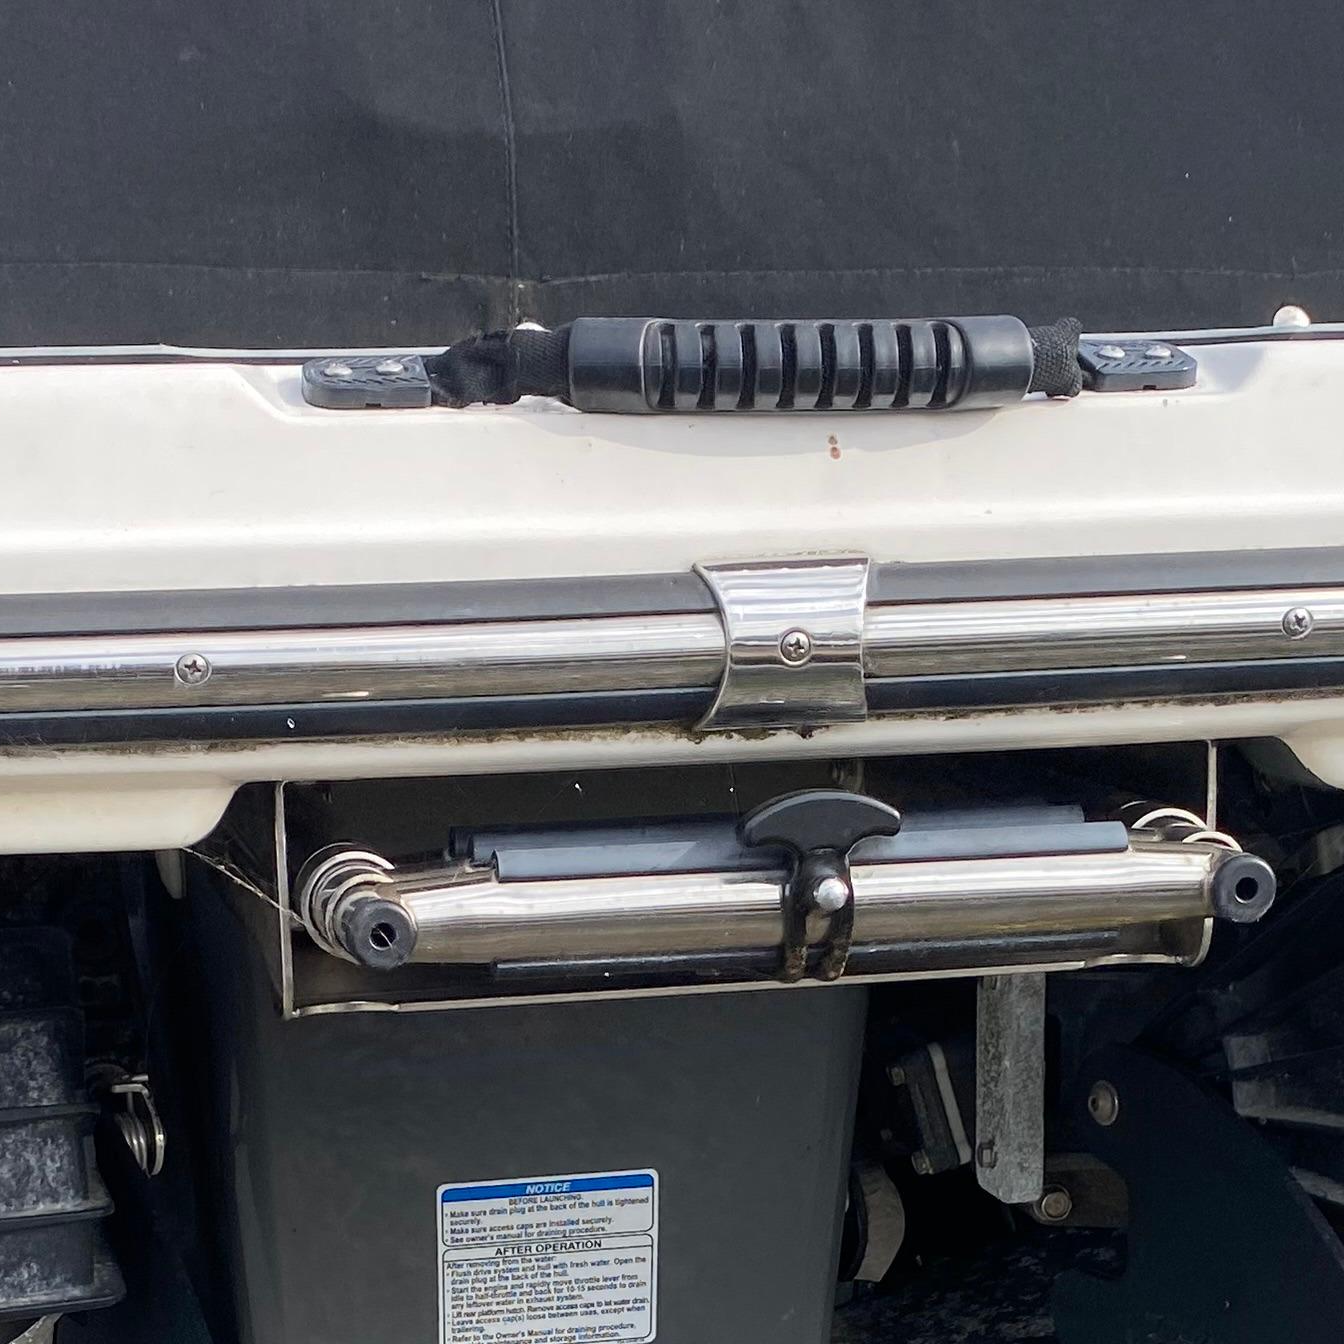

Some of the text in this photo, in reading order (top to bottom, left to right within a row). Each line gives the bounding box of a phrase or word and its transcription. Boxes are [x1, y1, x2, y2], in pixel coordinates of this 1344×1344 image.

[526, 1182, 570, 1194] NOTICE
[489, 1207, 508, 1215] drain
[509, 1206, 526, 1215] plug
[615, 1196, 649, 1206] tightened
[509, 1197, 538, 1206] BEFORE
[489, 1224, 514, 1232] access
[516, 1223, 534, 1231] caps
[549, 1218, 580, 1226] installed
[466, 1234, 494, 1242] owner's
[496, 1231, 523, 1239] manual
[536, 1229, 566, 1238] draining
[495, 1240, 602, 1256] AFTER OPERATION
[475, 1291, 517, 1299] half-throttle
[587, 1282, 617, 1291] seconds
[484, 1284, 508, 1293] engine
[526, 1280, 550, 1289] rapidly
[526, 1295, 554, 1304] exhaust
[478, 1309, 504, 1317] platform
[548, 1310, 578, 1318] between
[601, 1306, 625, 1314] except
[496, 1331, 525, 1339] Owner's
[527, 1328, 554, 1336] Manual
[567, 1325, 596, 1333] draining
[550, 1335, 576, 1344] storage
